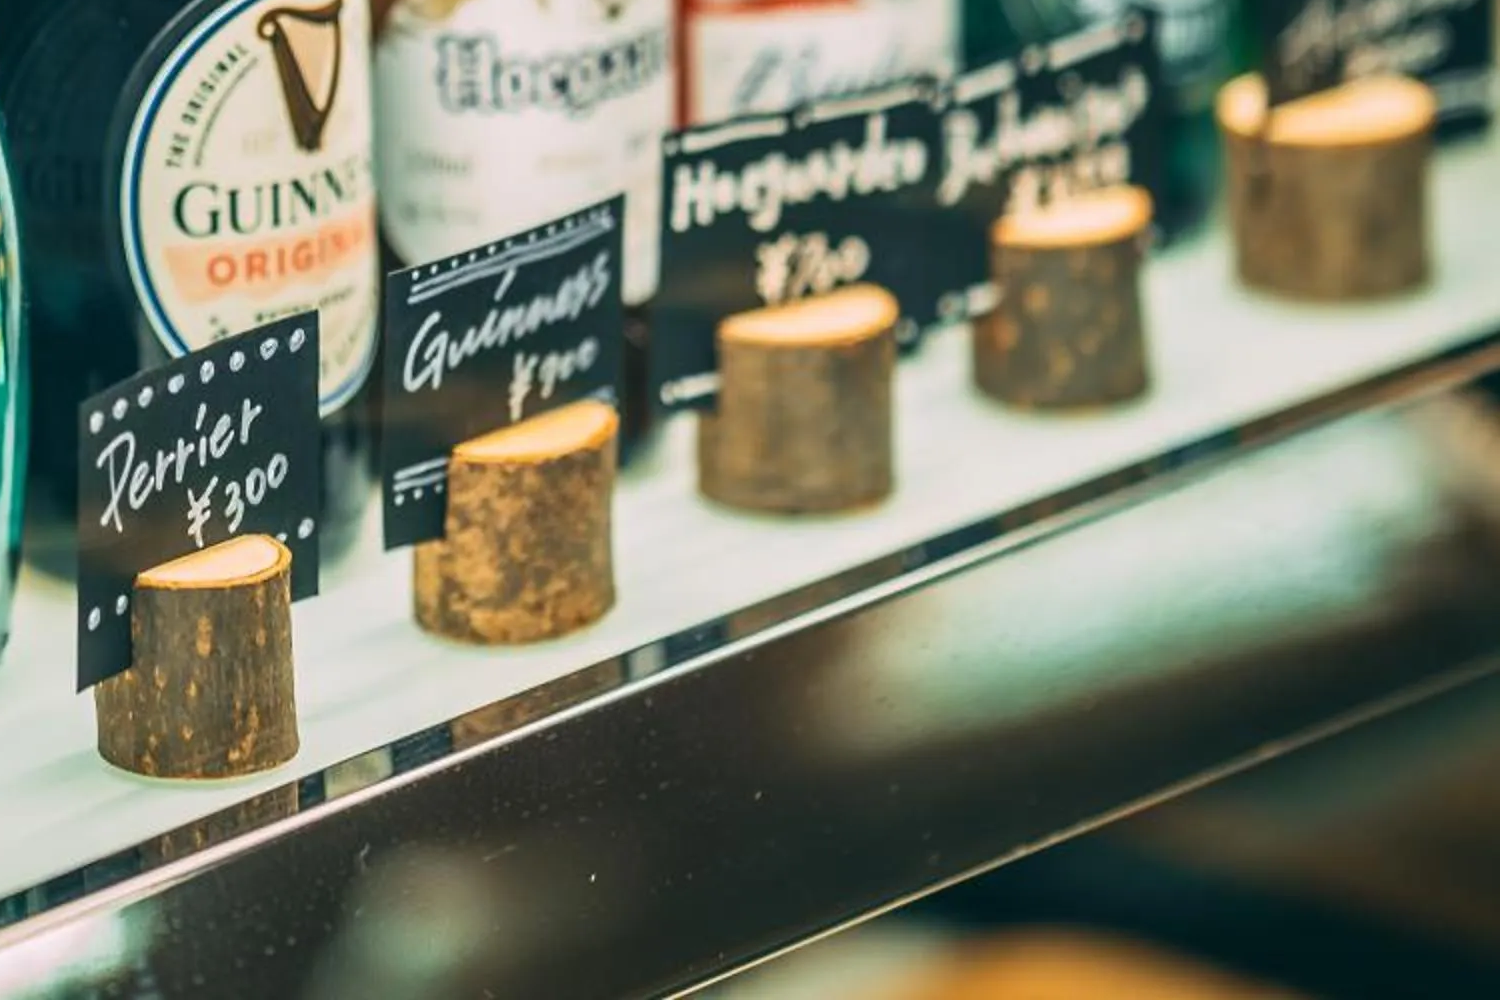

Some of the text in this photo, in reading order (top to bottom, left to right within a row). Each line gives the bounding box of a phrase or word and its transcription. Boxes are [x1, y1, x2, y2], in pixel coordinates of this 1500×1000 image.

[164, 131, 190, 169] THE
[96, 398, 263, 534] Perrier
[186, 452, 289, 548] ¥300
